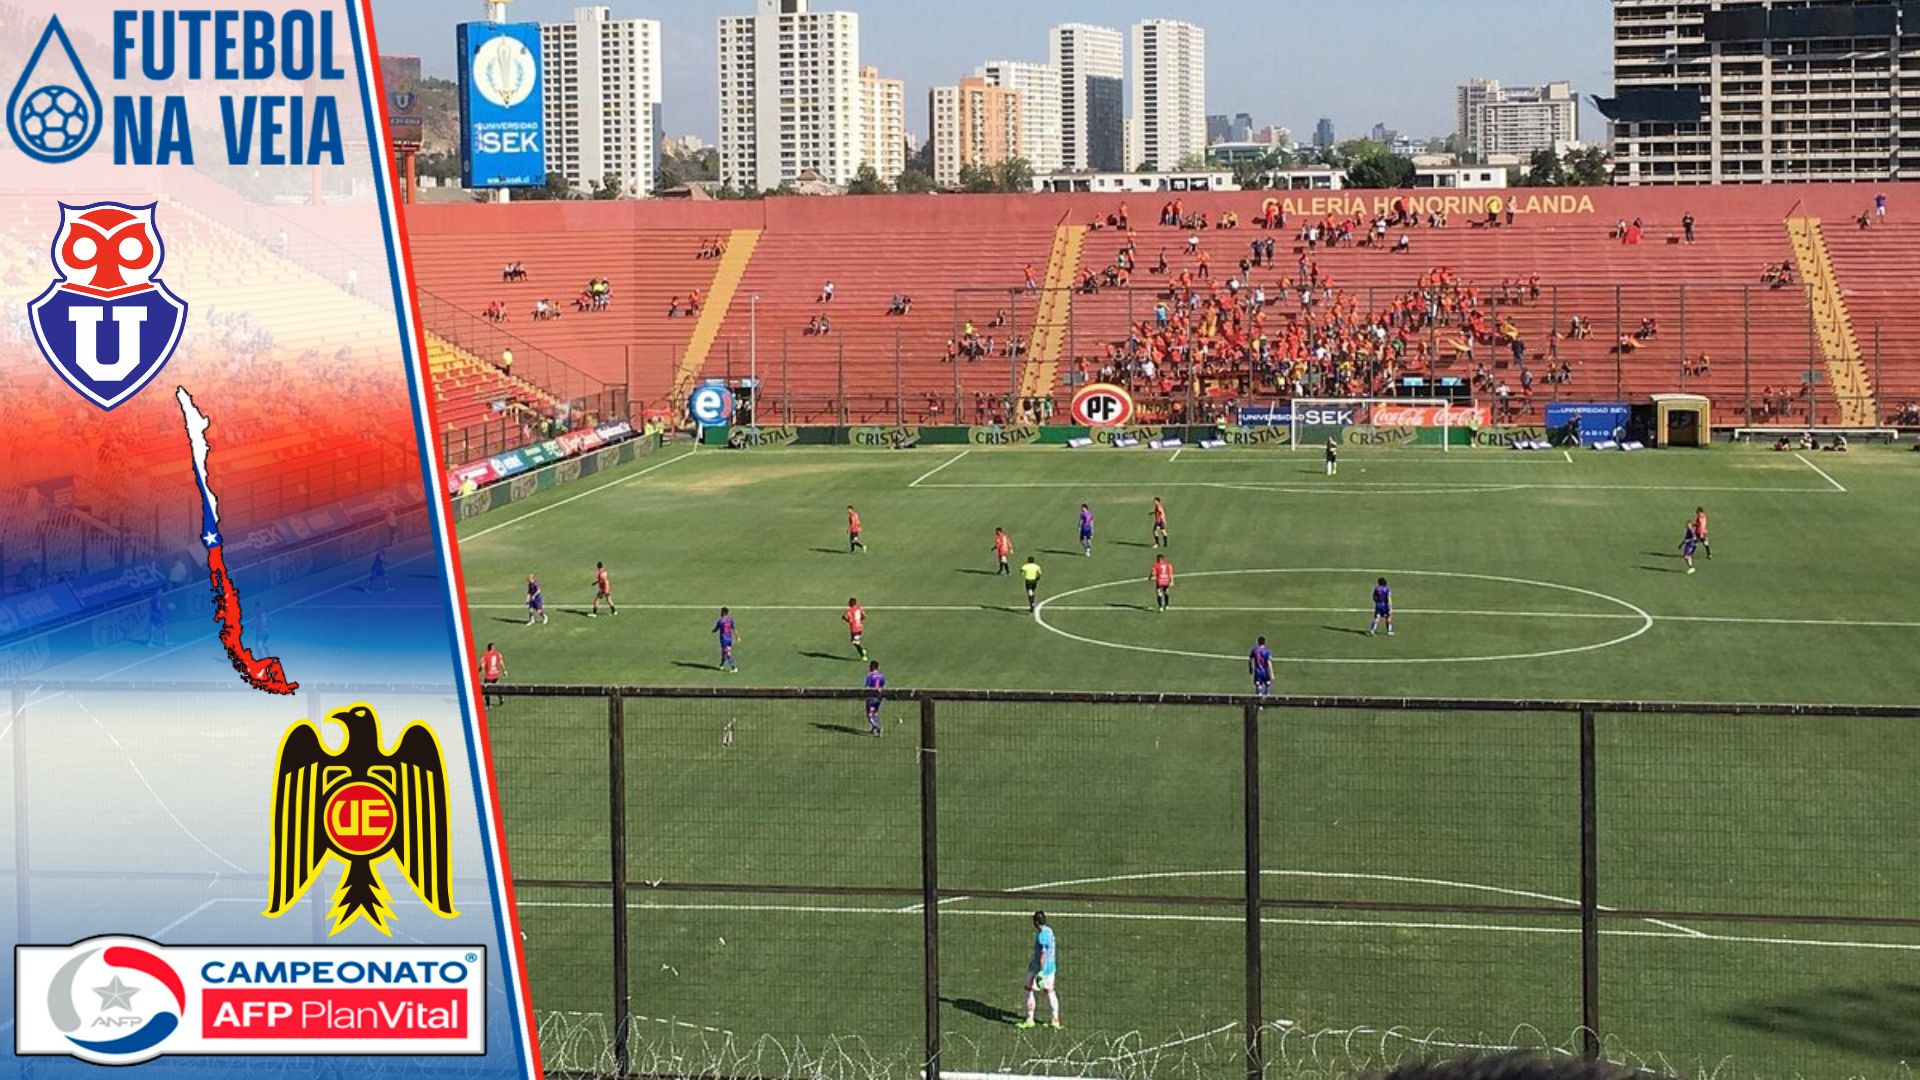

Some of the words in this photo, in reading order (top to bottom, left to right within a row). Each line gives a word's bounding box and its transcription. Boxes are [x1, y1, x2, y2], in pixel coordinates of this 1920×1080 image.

[482, 132, 540, 153] SEK
[1087, 395, 1117, 420] PF
[1305, 410, 1353, 425] SEK
[975, 426, 1036, 445] CRISTAL
[1224, 426, 1285, 445] CRISTAL
[1349, 425, 1411, 445] CRISTAL
